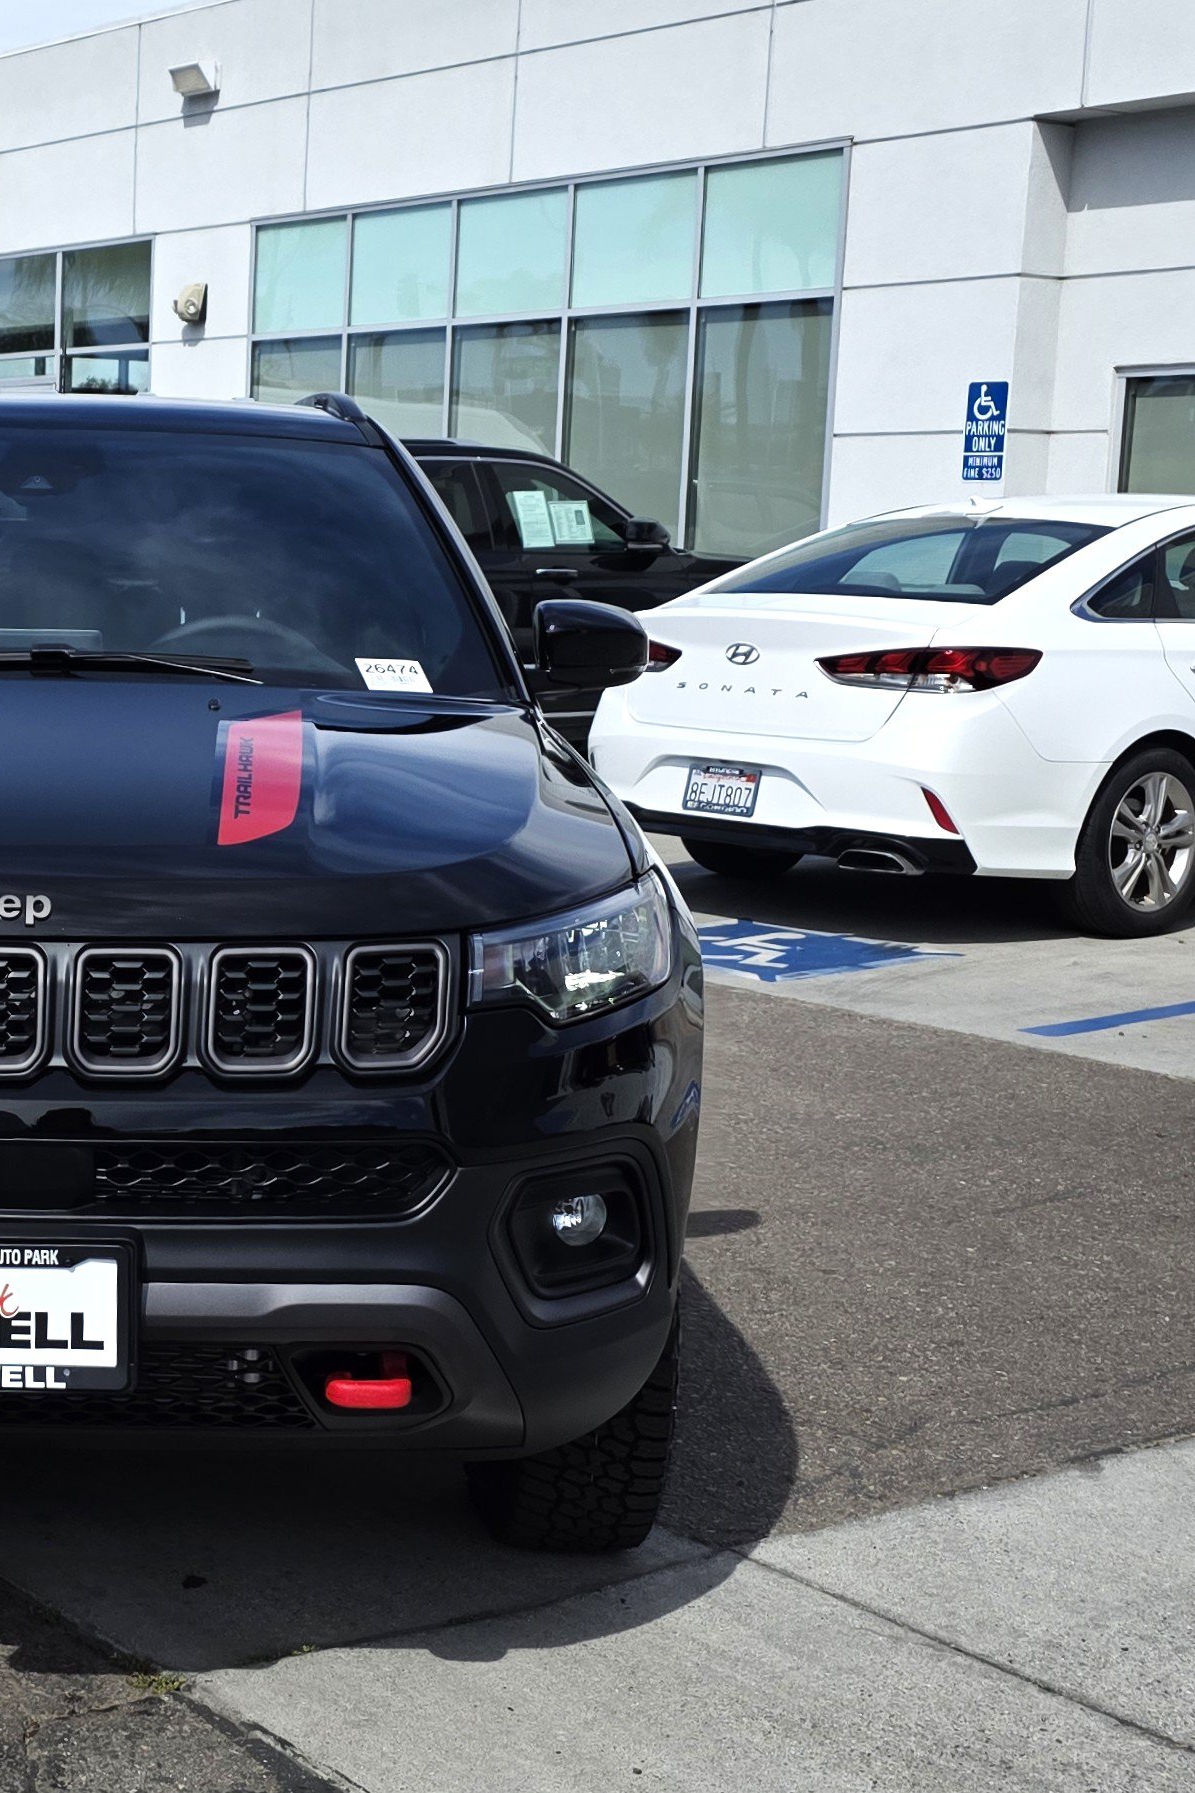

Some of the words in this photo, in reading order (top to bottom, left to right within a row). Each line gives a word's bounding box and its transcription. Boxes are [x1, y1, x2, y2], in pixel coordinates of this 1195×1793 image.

[966, 420, 1005, 435] PARKING
[972, 437, 997, 451] ONLY
[968, 456, 998, 467] MINIMUM
[964, 467, 980, 478] FINE
[982, 467, 1001, 478] $250
[364, 663, 419, 675] 26474
[676, 681, 809, 699] SONATA
[234, 736, 254, 819] TRAILHAWK
[23, 1249, 60, 1266] PARK
